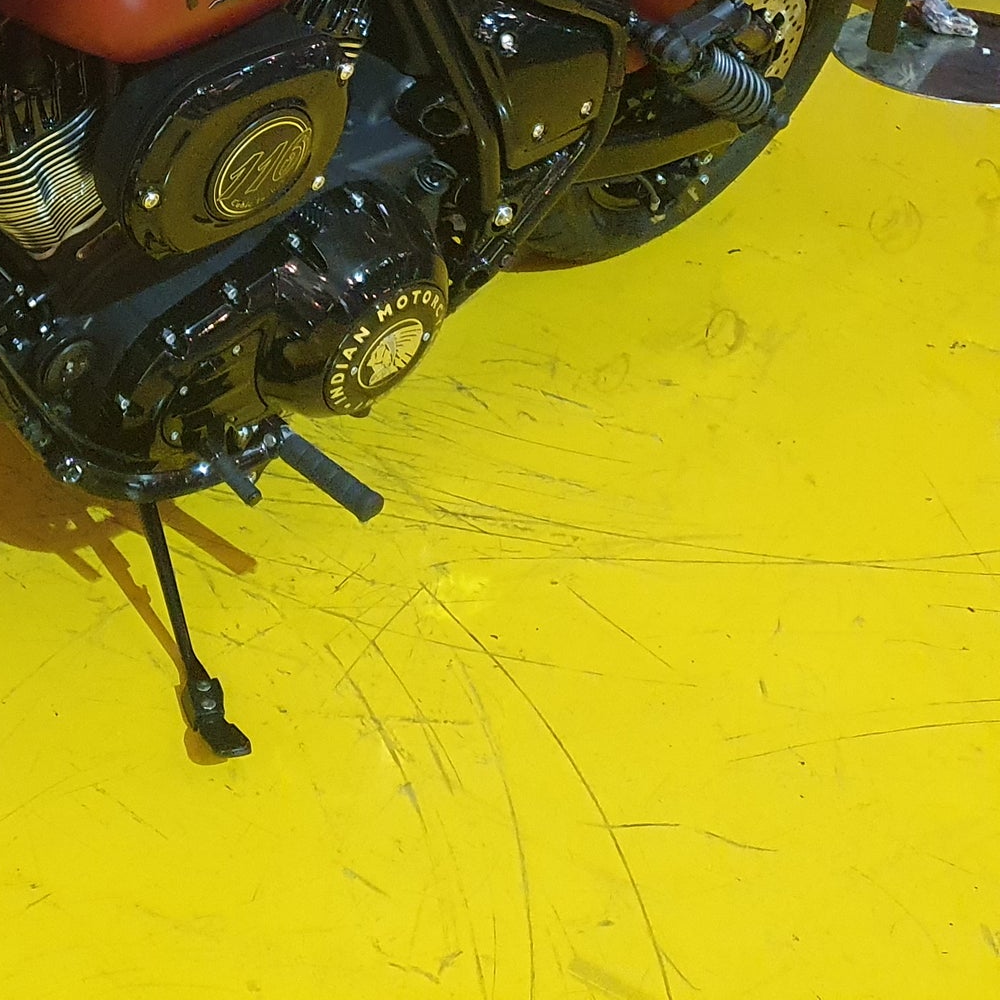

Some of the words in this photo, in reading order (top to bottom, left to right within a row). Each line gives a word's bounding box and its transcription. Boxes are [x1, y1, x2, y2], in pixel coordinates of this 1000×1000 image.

[216, 126, 312, 202] 116
[329, 325, 372, 406] INDIAN
[376, 289, 444, 323] MOTORC
